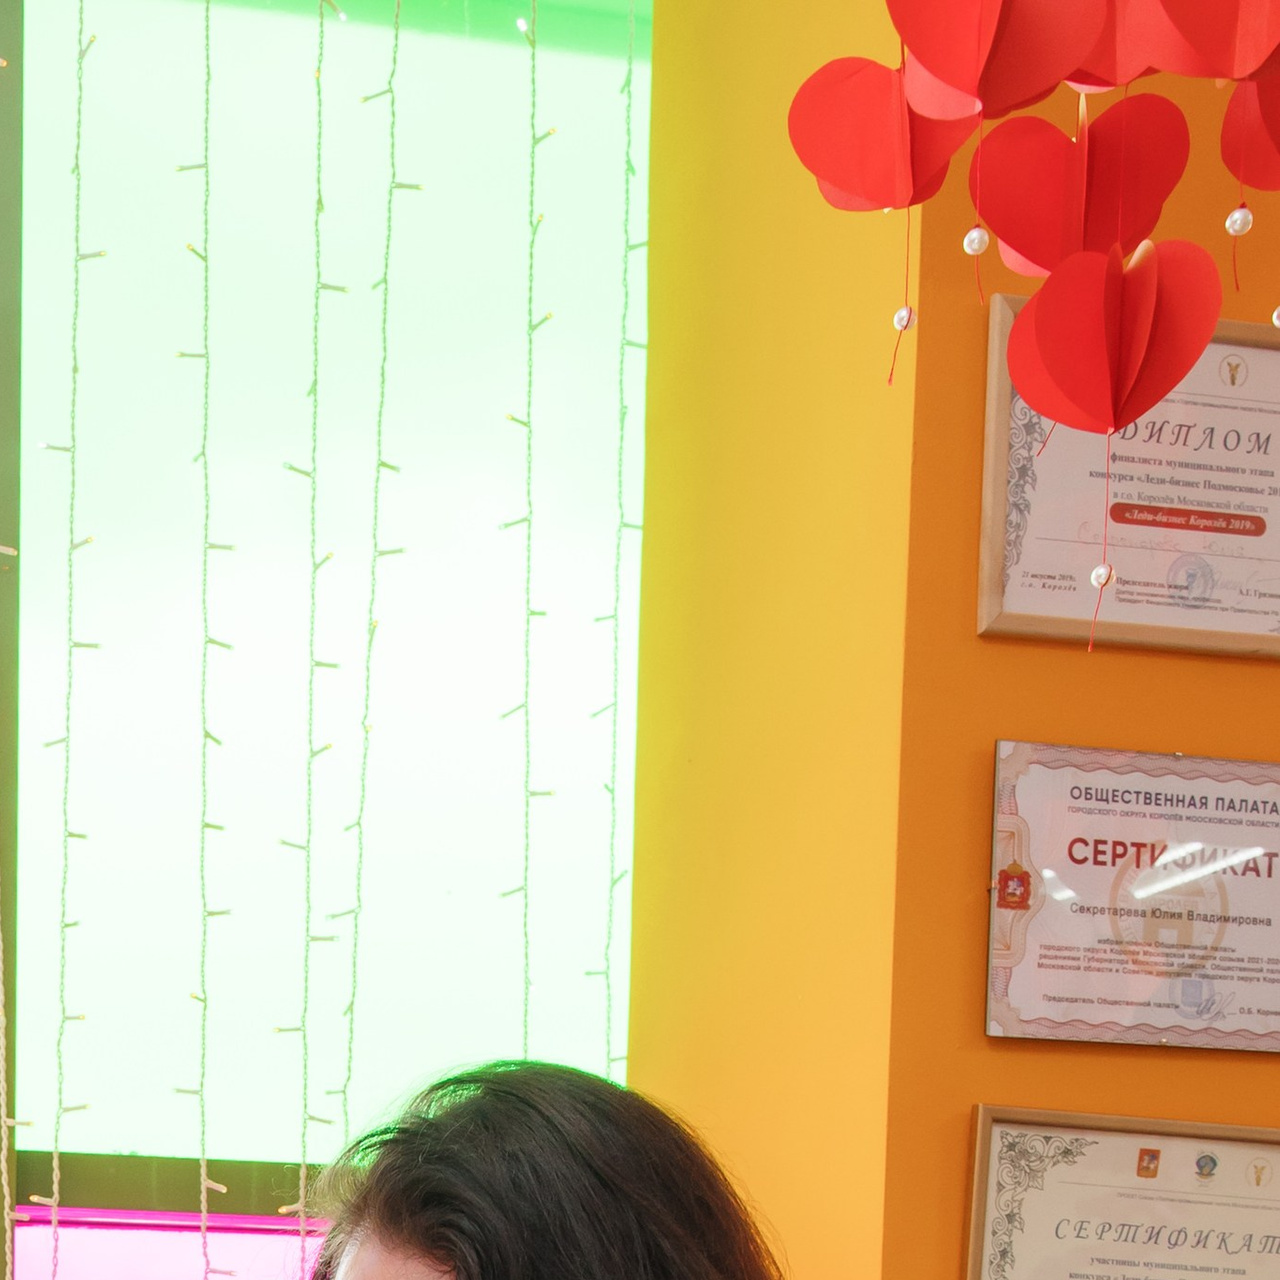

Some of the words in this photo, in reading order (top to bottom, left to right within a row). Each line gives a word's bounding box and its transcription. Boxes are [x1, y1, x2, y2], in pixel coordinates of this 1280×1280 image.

[1118, 419, 1272, 456] ДИПЛОМ
[1110, 451, 1163, 467] финалиста
[1165, 459, 1247, 475] муниципального
[1249, 468, 1275, 478] этапа
[1089, 469, 1134, 486] конкурса
[1203, 480, 1266, 497] Подмосковье
[1177, 494, 1231, 511] Московской
[1233, 500, 1269, 514] области
[1070, 785, 1209, 810] ОБЩЕСТВЕННАЯ
[1215, 797, 1280, 816] ПАЛАТА
[1067, 806, 1118, 817] ГОРОДСКОГО
[1119, 810, 1148, 819] ОКРУГА
[1245, 819, 1280, 829] ОБЛАСТИ
[1070, 902, 1147, 918] Секретарева
[1150, 908, 1183, 920] Юлия
[1187, 910, 1272, 927] Владимировна
[1055, 1218, 1280, 1256] СЕРТИФИКАТ
